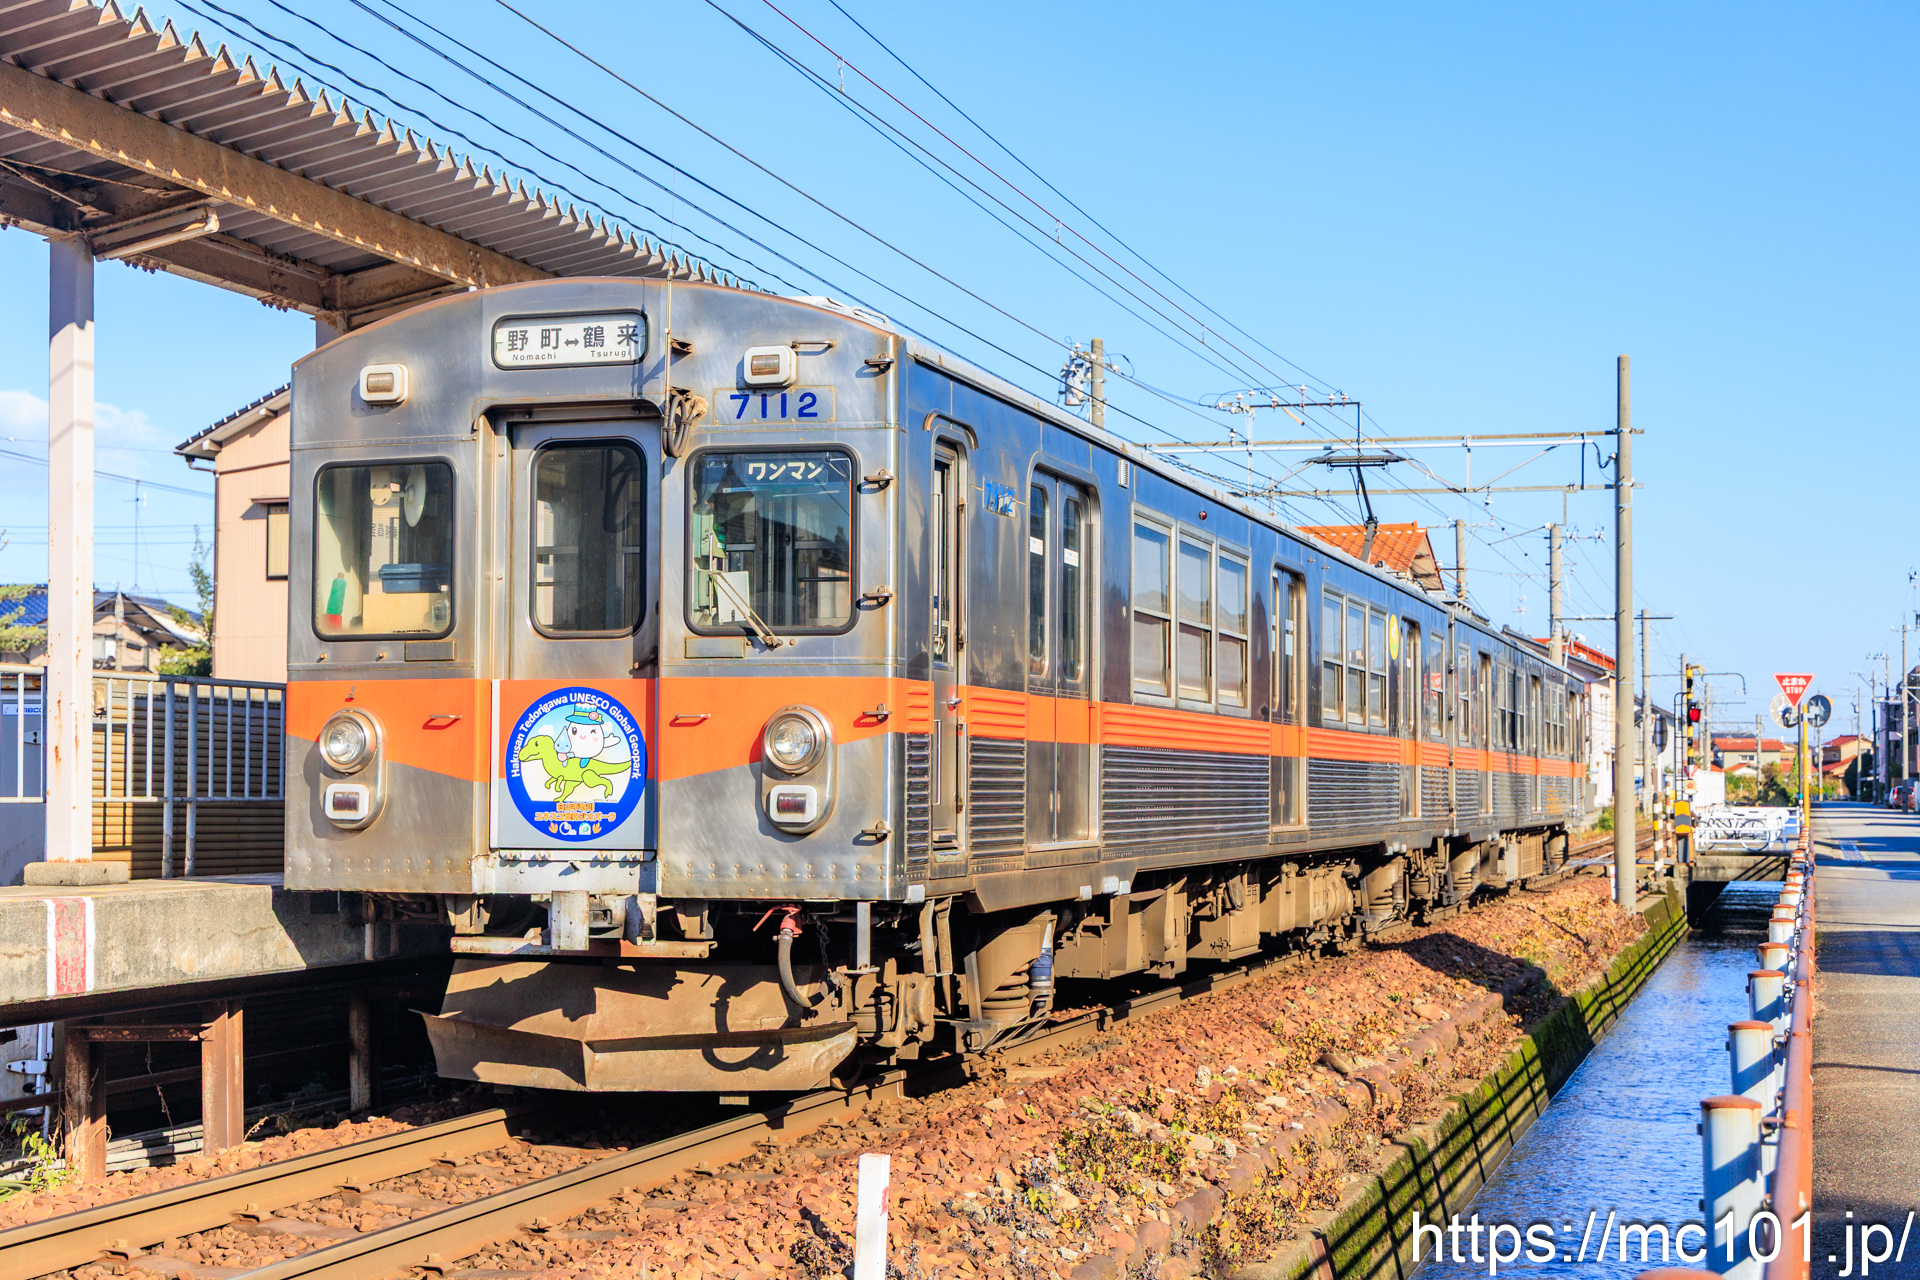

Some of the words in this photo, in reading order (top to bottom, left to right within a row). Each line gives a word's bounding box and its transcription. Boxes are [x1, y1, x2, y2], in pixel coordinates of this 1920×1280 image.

[507, 327, 562, 351] 野町
[583, 324, 639, 348] 鶴来
[512, 352, 557, 361] Nomachi
[590, 348, 631, 358] Tsurugi
[730, 392, 818, 420] 7112
[748, 461, 825, 481] ワンマン
[986, 483, 1013, 513] 7112
[1782, 677, 1806, 686] 止まれ
[510, 733, 525, 777] Hakusan
[519, 695, 568, 733] Tedorigawa
[569, 692, 610, 710] UNESCO
[609, 706, 635, 735] Global
[629, 734, 641, 779] Geopark
